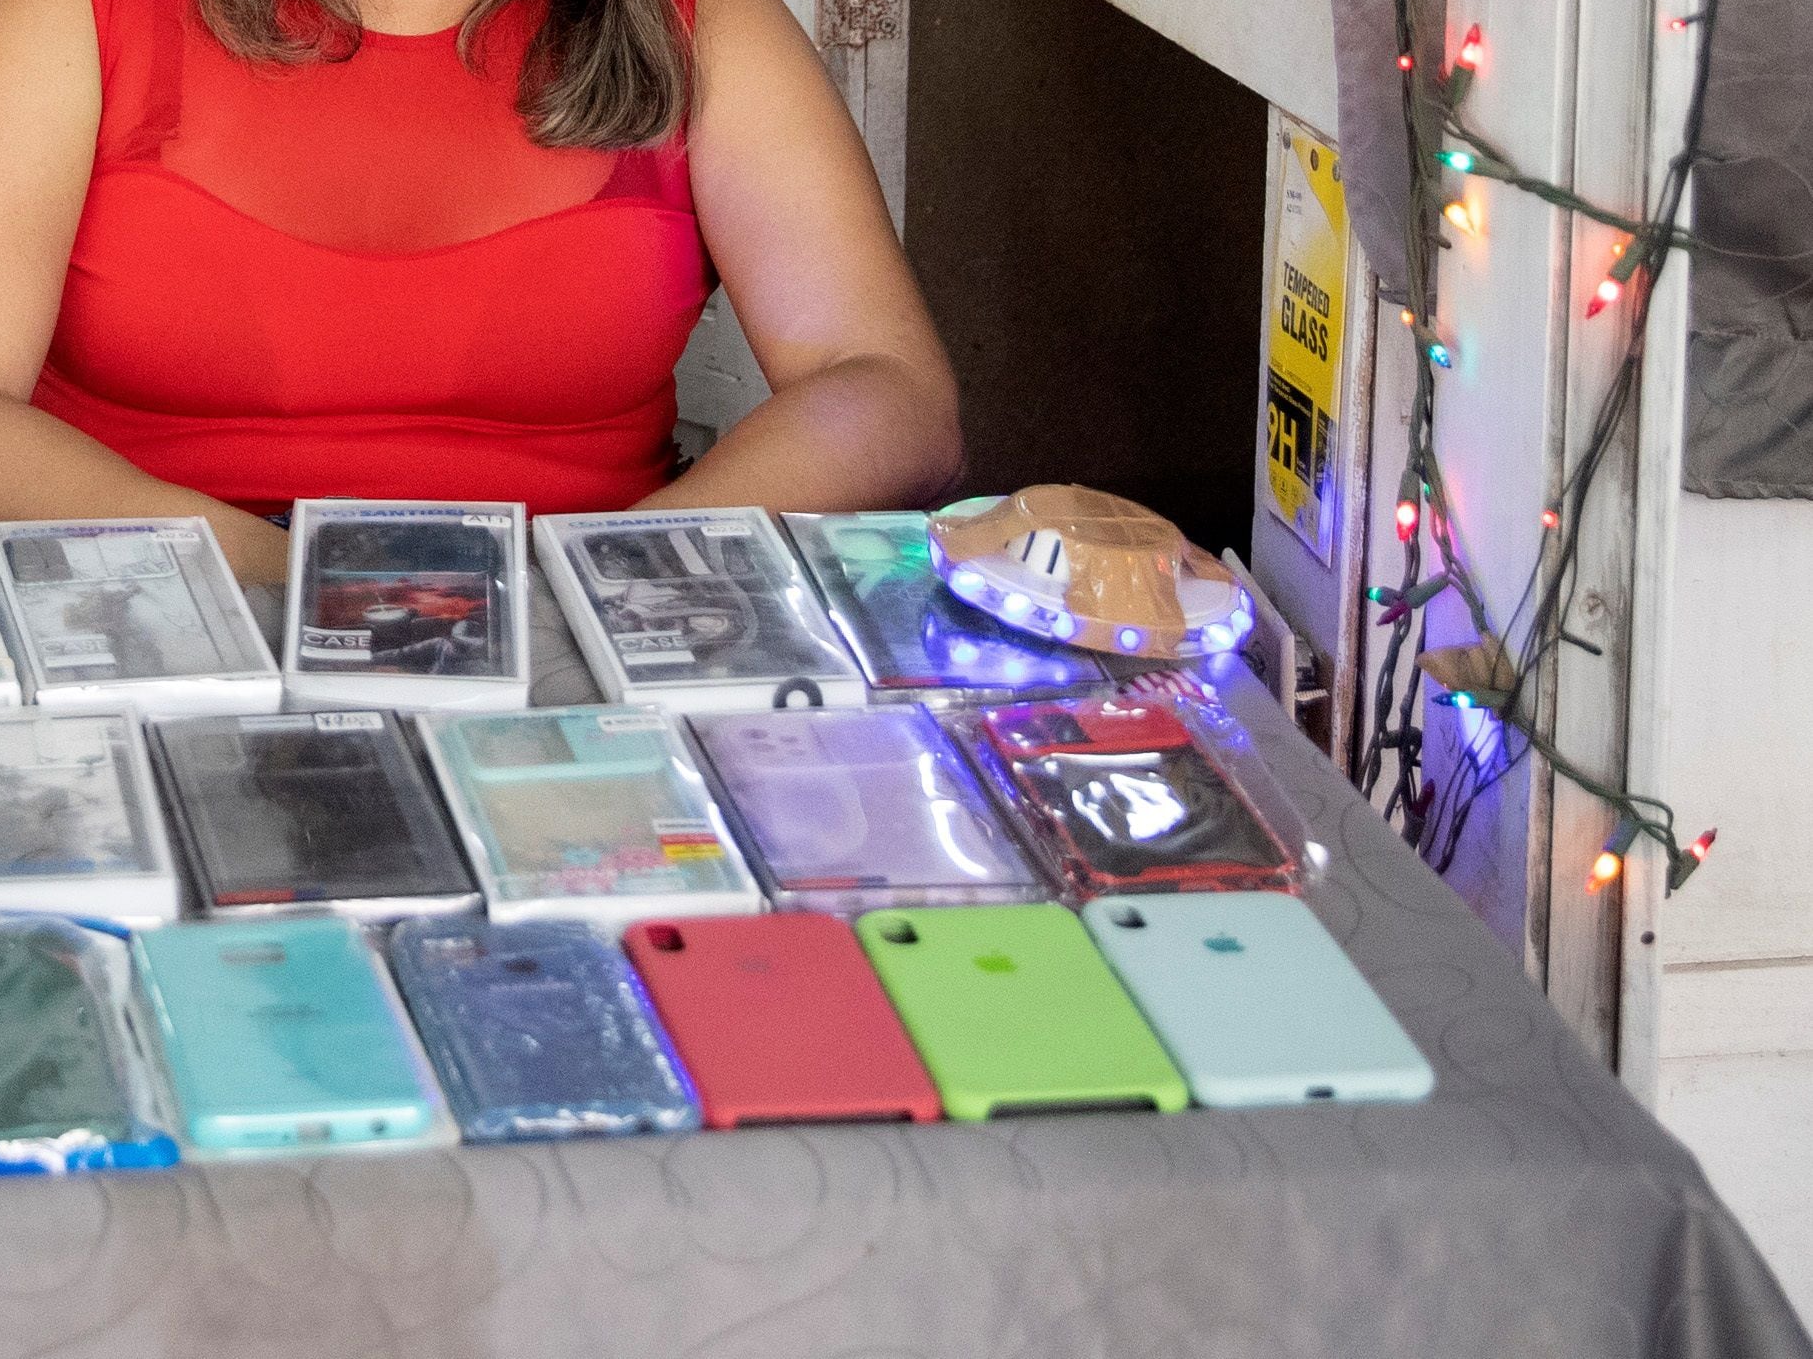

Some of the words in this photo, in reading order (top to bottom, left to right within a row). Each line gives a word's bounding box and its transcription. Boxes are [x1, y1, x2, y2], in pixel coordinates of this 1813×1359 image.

[1283, 261, 1330, 319] TEMPERED
[1281, 294, 1328, 362] GLASS
[1268, 401, 1297, 474] 9H
[304, 633, 371, 648] CASE
[618, 635, 686, 650] CASE
